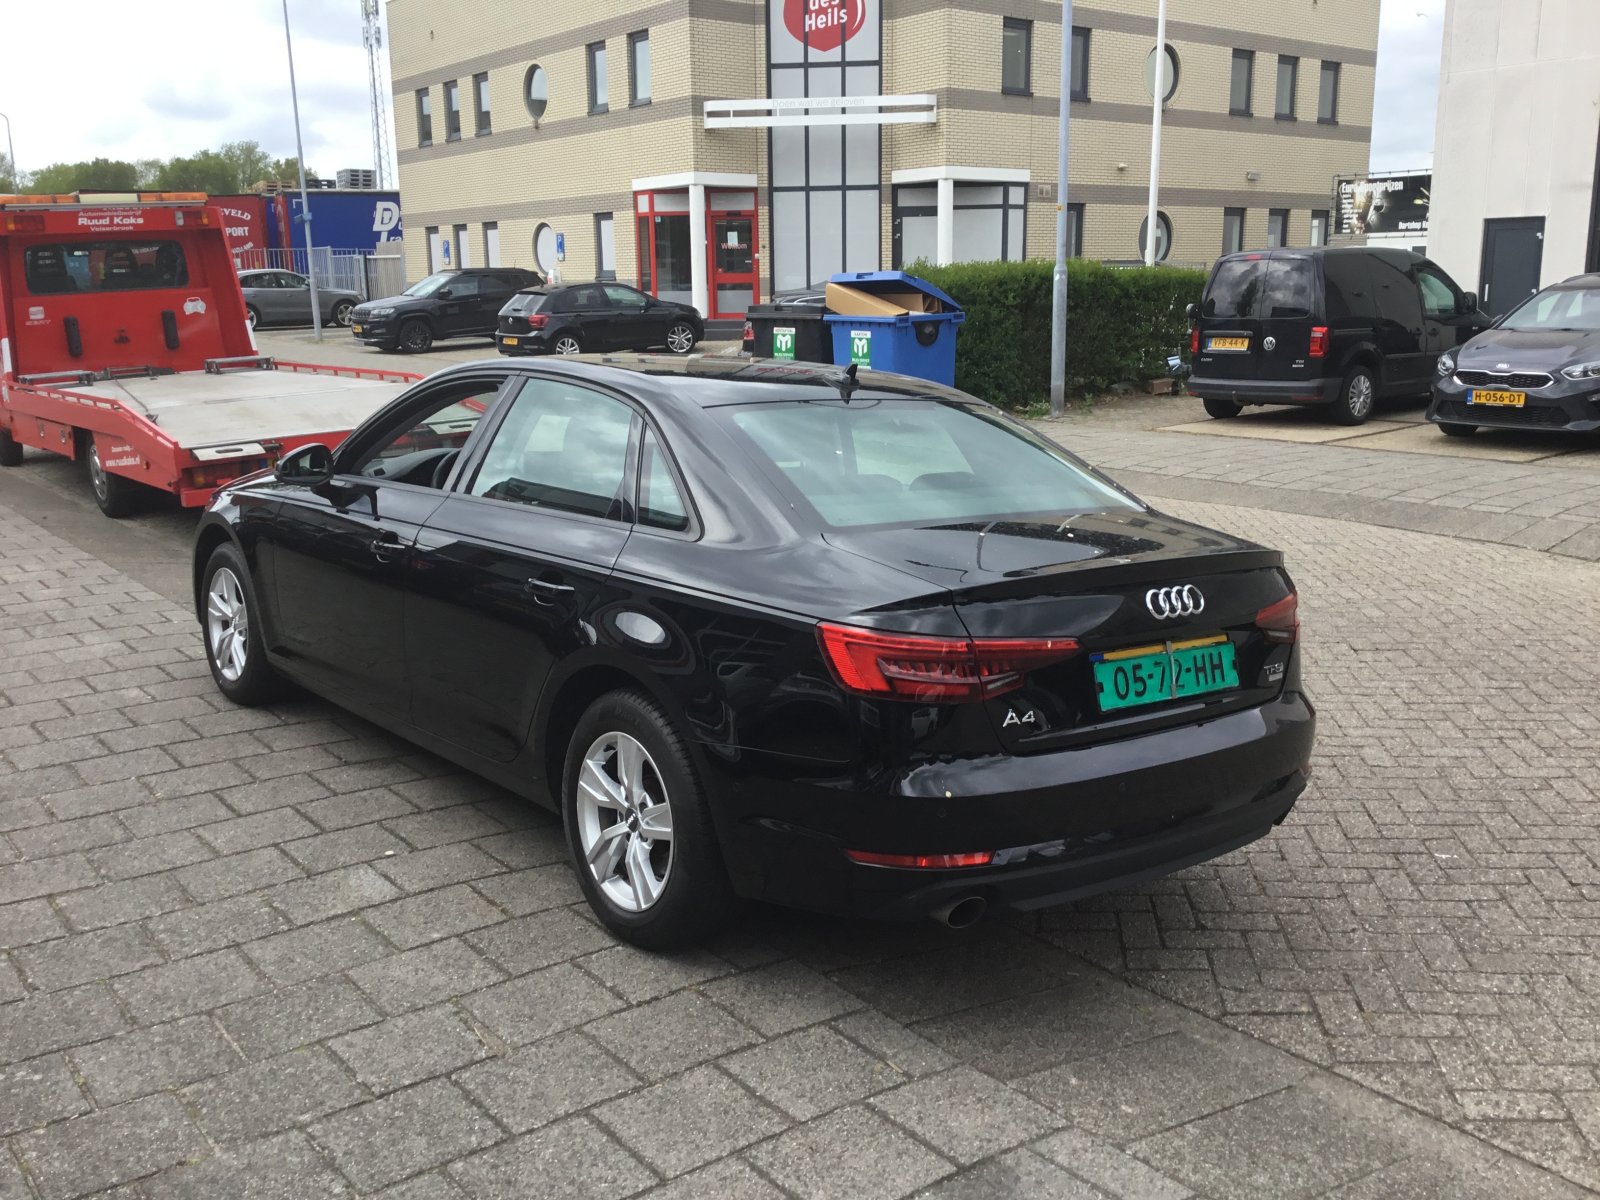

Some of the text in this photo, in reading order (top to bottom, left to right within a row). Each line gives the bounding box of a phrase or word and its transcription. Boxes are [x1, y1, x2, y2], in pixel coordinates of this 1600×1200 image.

[804, 7, 848, 32] Heils
[799, 99, 813, 108] wat
[816, 99, 829, 107] we
[830, 98, 865, 107] geloven
[78, 215, 144, 226] Ruud Koks
[1475, 391, 1522, 403] H-056-DT
[1113, 651, 1225, 700] 05-72-HH
[1002, 708, 1036, 728] A4
